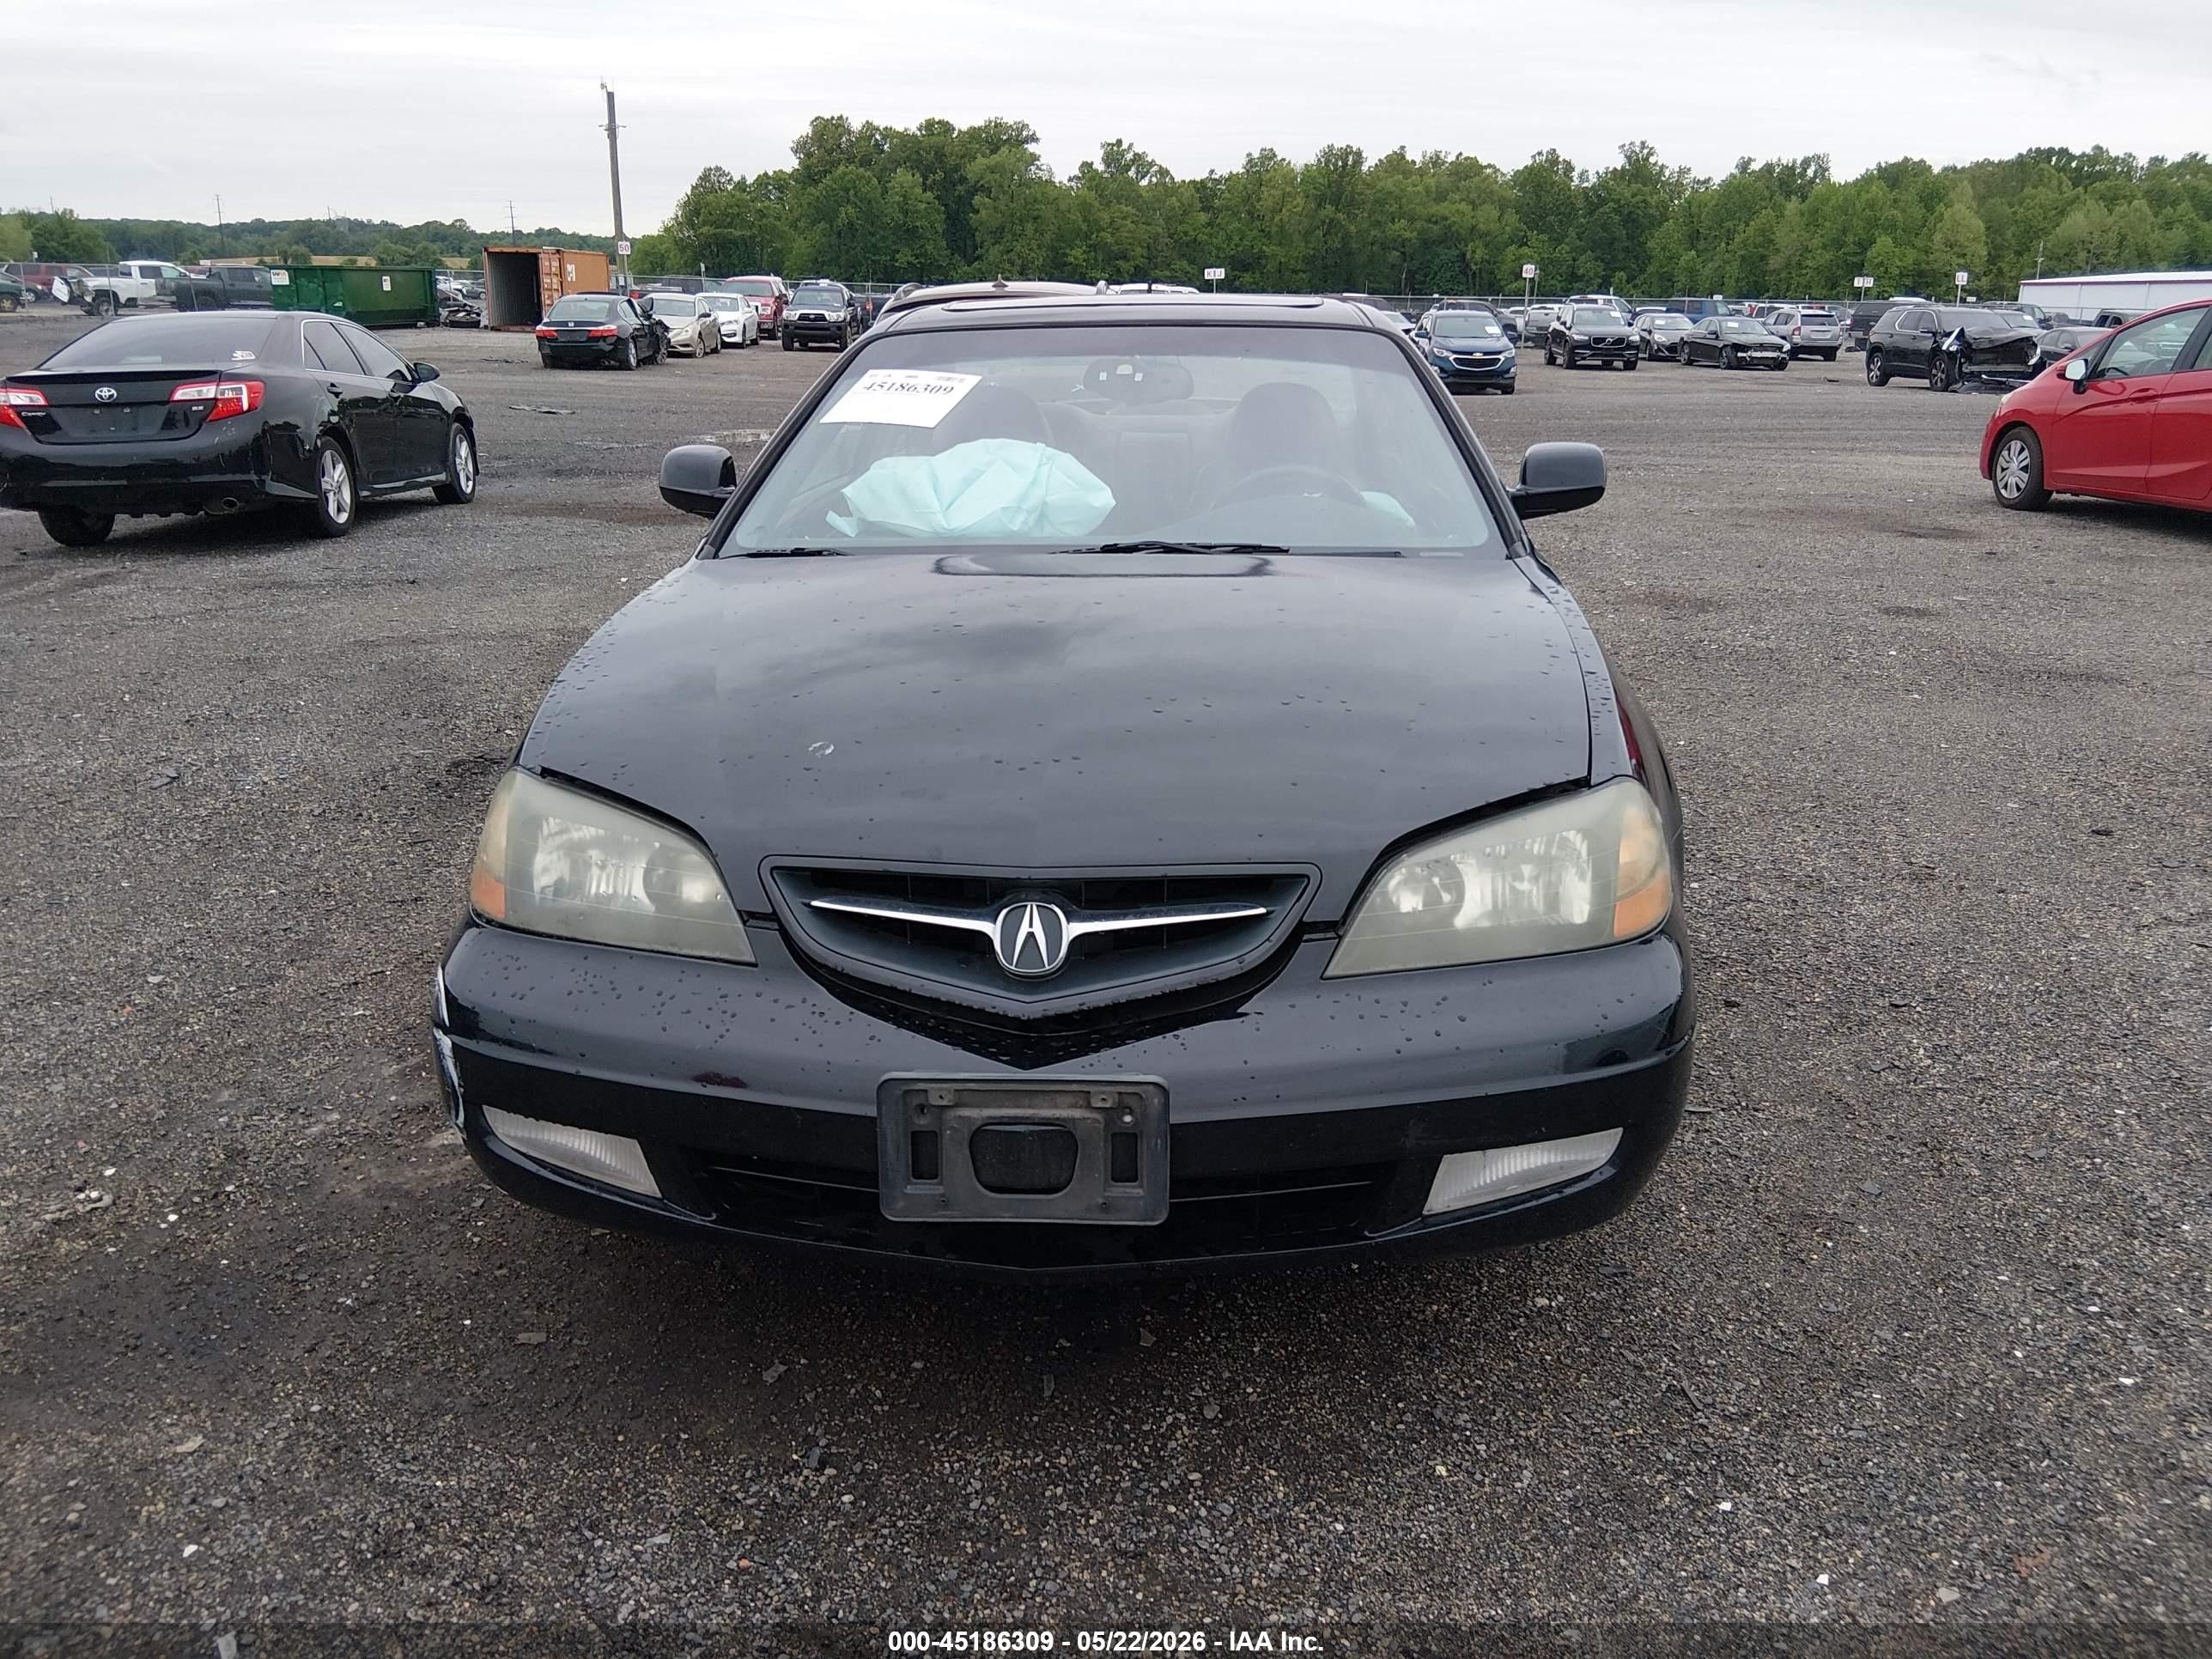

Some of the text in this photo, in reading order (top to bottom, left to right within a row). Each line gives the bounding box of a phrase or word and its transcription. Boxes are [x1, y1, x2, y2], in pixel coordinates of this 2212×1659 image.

[619, 244, 629, 252] 50
[1523, 267, 1534, 276] 40
[863, 381, 955, 394] 45186309
